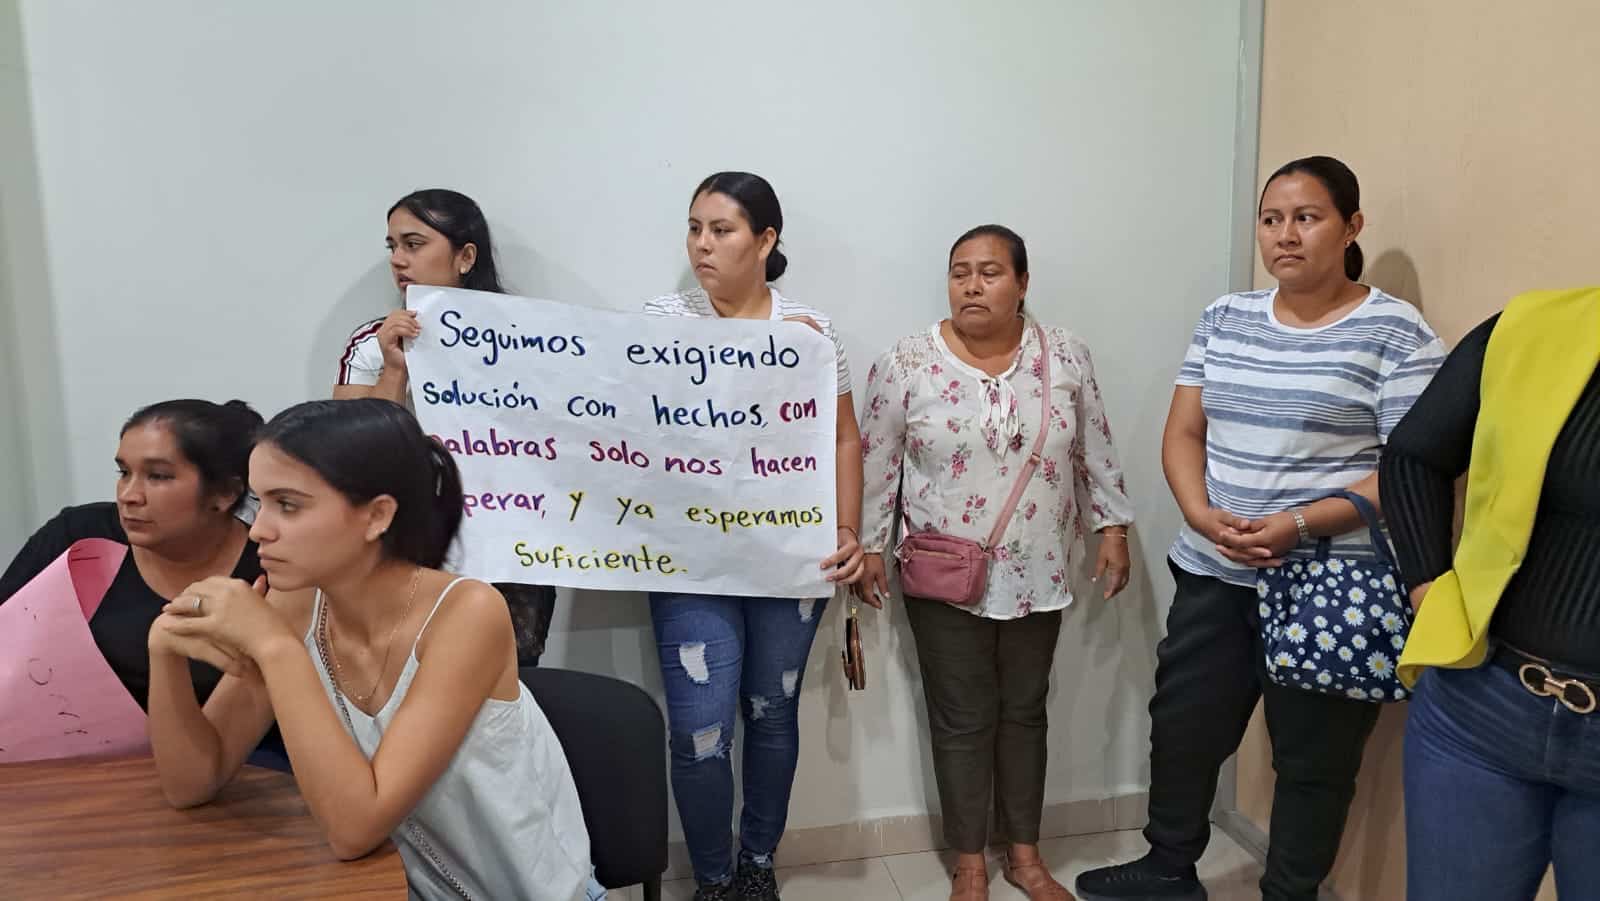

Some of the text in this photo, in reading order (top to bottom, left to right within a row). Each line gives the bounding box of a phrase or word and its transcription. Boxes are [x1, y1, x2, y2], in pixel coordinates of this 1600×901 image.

[439, 310, 800, 384] Seguimos exigiendo
[567, 395, 616, 419] con
[652, 394, 768, 428] hechos,
[431, 427, 817, 477] alabras solo nos hacen
[463, 492, 546, 520] perar,
[686, 505, 824, 534] esperamos
